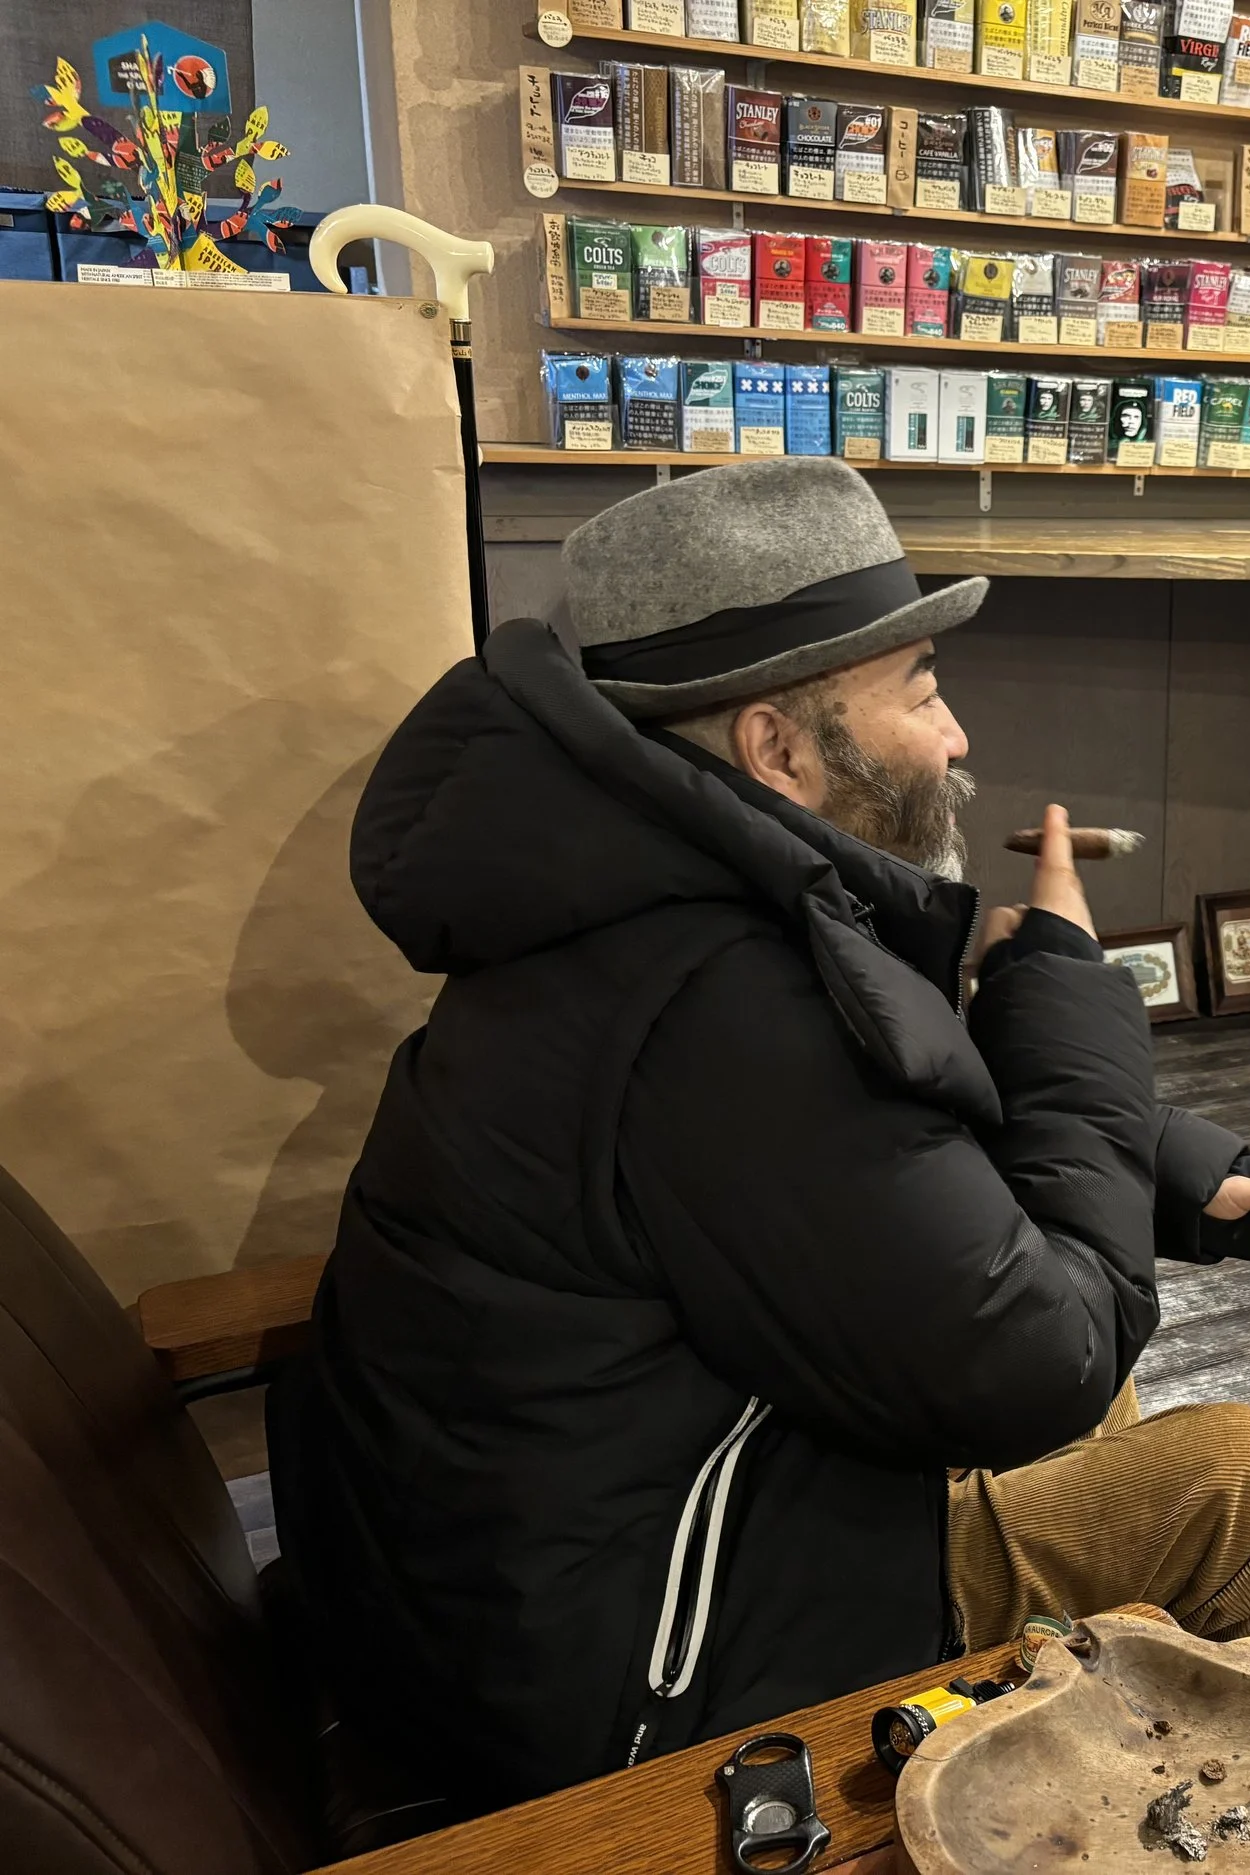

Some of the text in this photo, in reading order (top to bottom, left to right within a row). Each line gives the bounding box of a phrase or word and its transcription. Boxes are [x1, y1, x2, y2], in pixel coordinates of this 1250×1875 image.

[861, 7, 914, 35] STANLEY
[735, 102, 779, 124] STANLEY
[797, 134, 833, 143] CHOCOLATE
[201, 245, 238, 273] AMERICAN
[584, 246, 623, 265] COLTS
[710, 256, 746, 273] COLTS
[1194, 273, 1228, 289] STANLEY
[563, 392, 591, 400] MENTHOL
[846, 391, 881, 408] COLTS
[1172, 388, 1198, 404] RED
[1210, 396, 1243, 408] CAMEL
[1172, 404, 1196, 418] FIELD
[627, 1723, 648, 1769] and wa
